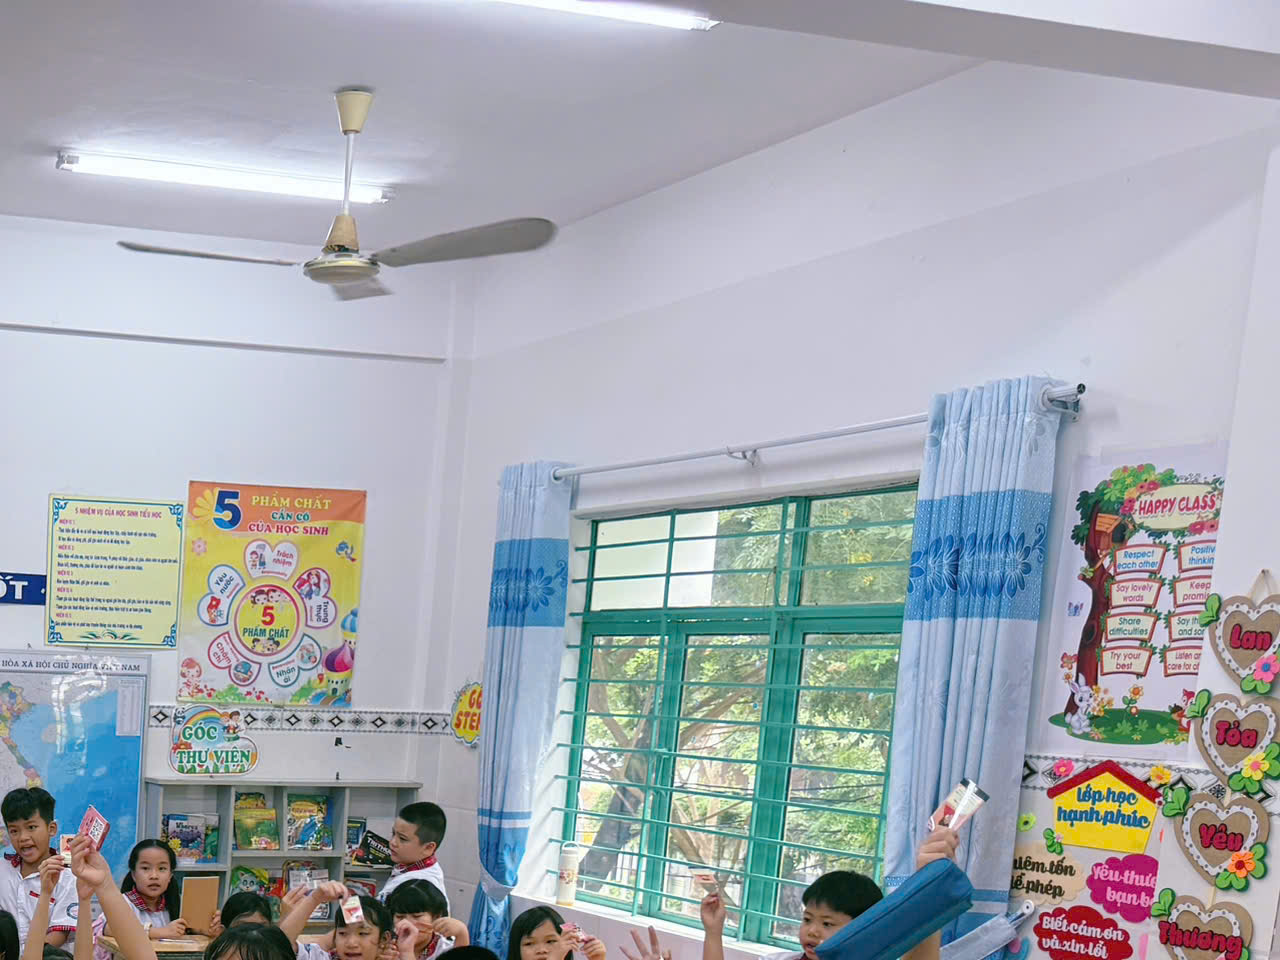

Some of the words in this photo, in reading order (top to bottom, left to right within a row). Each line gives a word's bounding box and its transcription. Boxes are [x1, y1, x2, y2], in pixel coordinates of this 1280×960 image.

[252, 491, 290, 508] PHẨM
[294, 494, 332, 510] CHẤT
[1139, 497, 1176, 516] HAPPY
[1178, 494, 1216, 513] CLASS
[213, 490, 242, 530] 5
[296, 511, 310, 521] CÓ
[248, 520, 272, 533] CỦA
[276, 524, 300, 536] HỌC
[303, 526, 329, 536] SINH
[1124, 550, 1154, 560] Respect
[1191, 546, 1216, 554] Positiv
[1118, 562, 1138, 570] each
[1139, 560, 1159, 569] other
[1189, 556, 1215, 565] thinkin
[1116, 584, 1129, 593] Say
[1131, 584, 1153, 592] lovely
[1190, 582, 1212, 591] Keep
[1123, 594, 1145, 602] words
[262, 605, 276, 626] 5
[1119, 618, 1141, 626] Share
[1177, 618, 1189, 626] Say
[1109, 628, 1149, 636] difficulties
[1178, 628, 1193, 636] and
[1230, 623, 1273, 651] Lan
[1110, 652, 1121, 661] Try
[1124, 653, 1141, 661] your
[1176, 652, 1193, 660] Listen
[36, 659, 51, 669] HỘI
[121, 664, 141, 672] NAM
[1116, 662, 1133, 670] best
[1184, 662, 1192, 670] for
[182, 718, 218, 742] GÓC
[1216, 720, 1258, 750] Tỏa
[176, 745, 210, 766] THƯ
[212, 746, 252, 768] VIỆN
[1106, 788, 1138, 808] học
[1057, 806, 1101, 827] hạnh
[1102, 807, 1150, 829] phúc
[1199, 822, 1244, 852] Yêu
[1093, 864, 1121, 882] Yêu
[1026, 879, 1065, 899] phép
[1106, 886, 1139, 907] bạn
[1069, 920, 1102, 938] cảm
[1103, 928, 1125, 941] ơn
[1042, 934, 1063, 950] và
